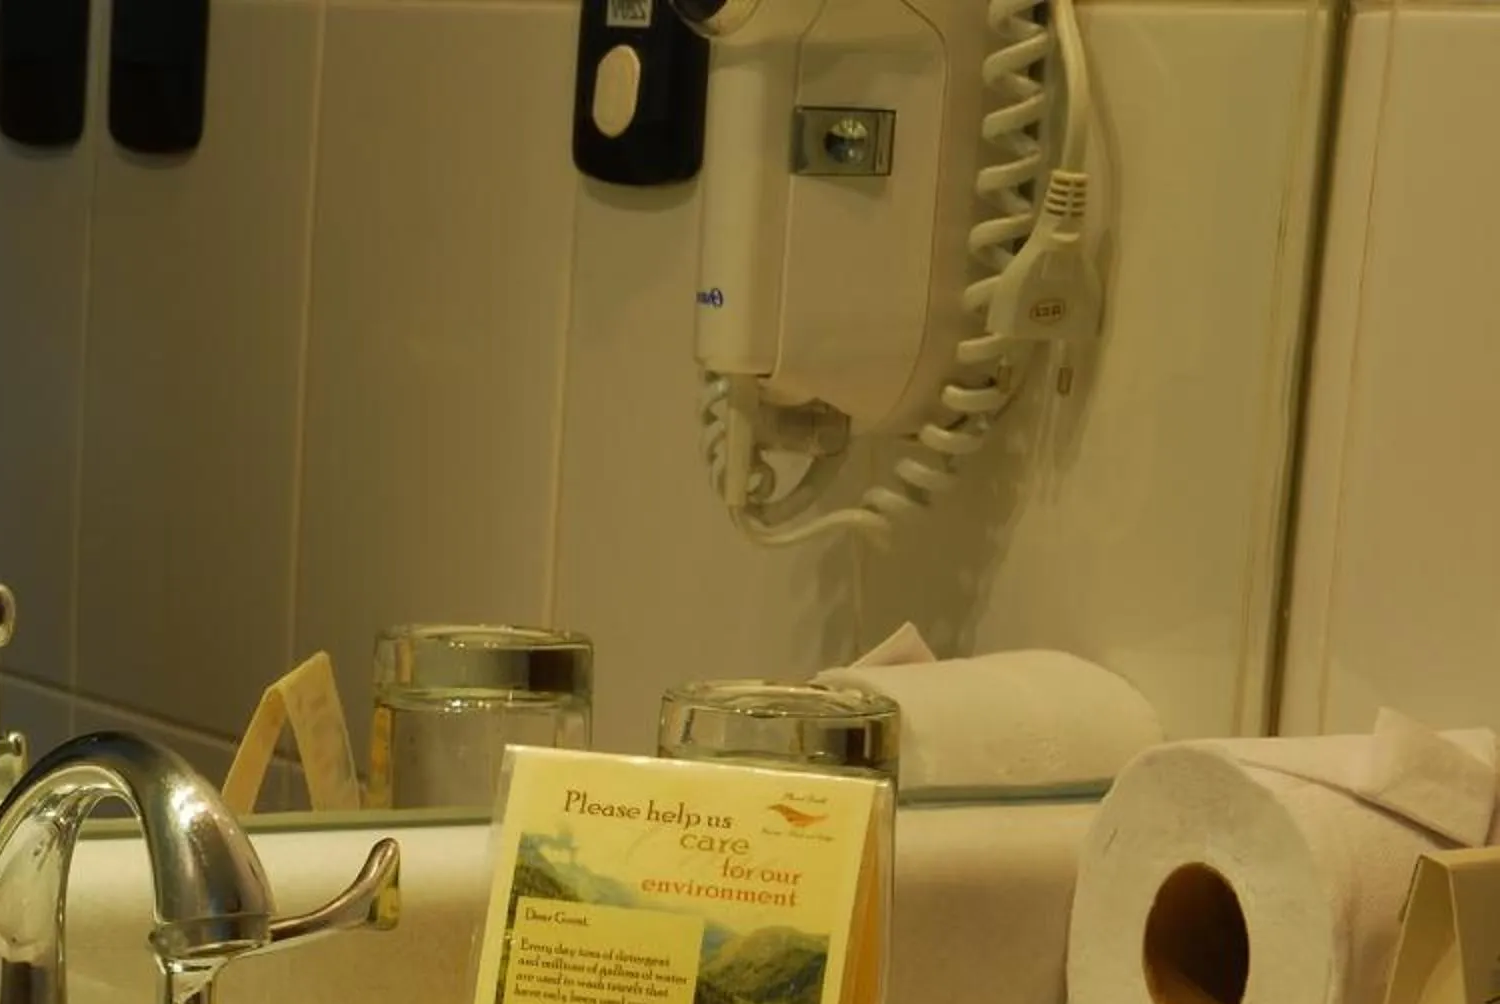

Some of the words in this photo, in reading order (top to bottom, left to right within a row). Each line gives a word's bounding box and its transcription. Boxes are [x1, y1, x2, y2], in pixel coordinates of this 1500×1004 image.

[564, 789, 641, 820] Please
[646, 800, 700, 829] help
[706, 814, 733, 829] us
[680, 832, 749, 855] care
[722, 858, 753, 879] for
[759, 870, 802, 885] our
[641, 877, 797, 908] environment
